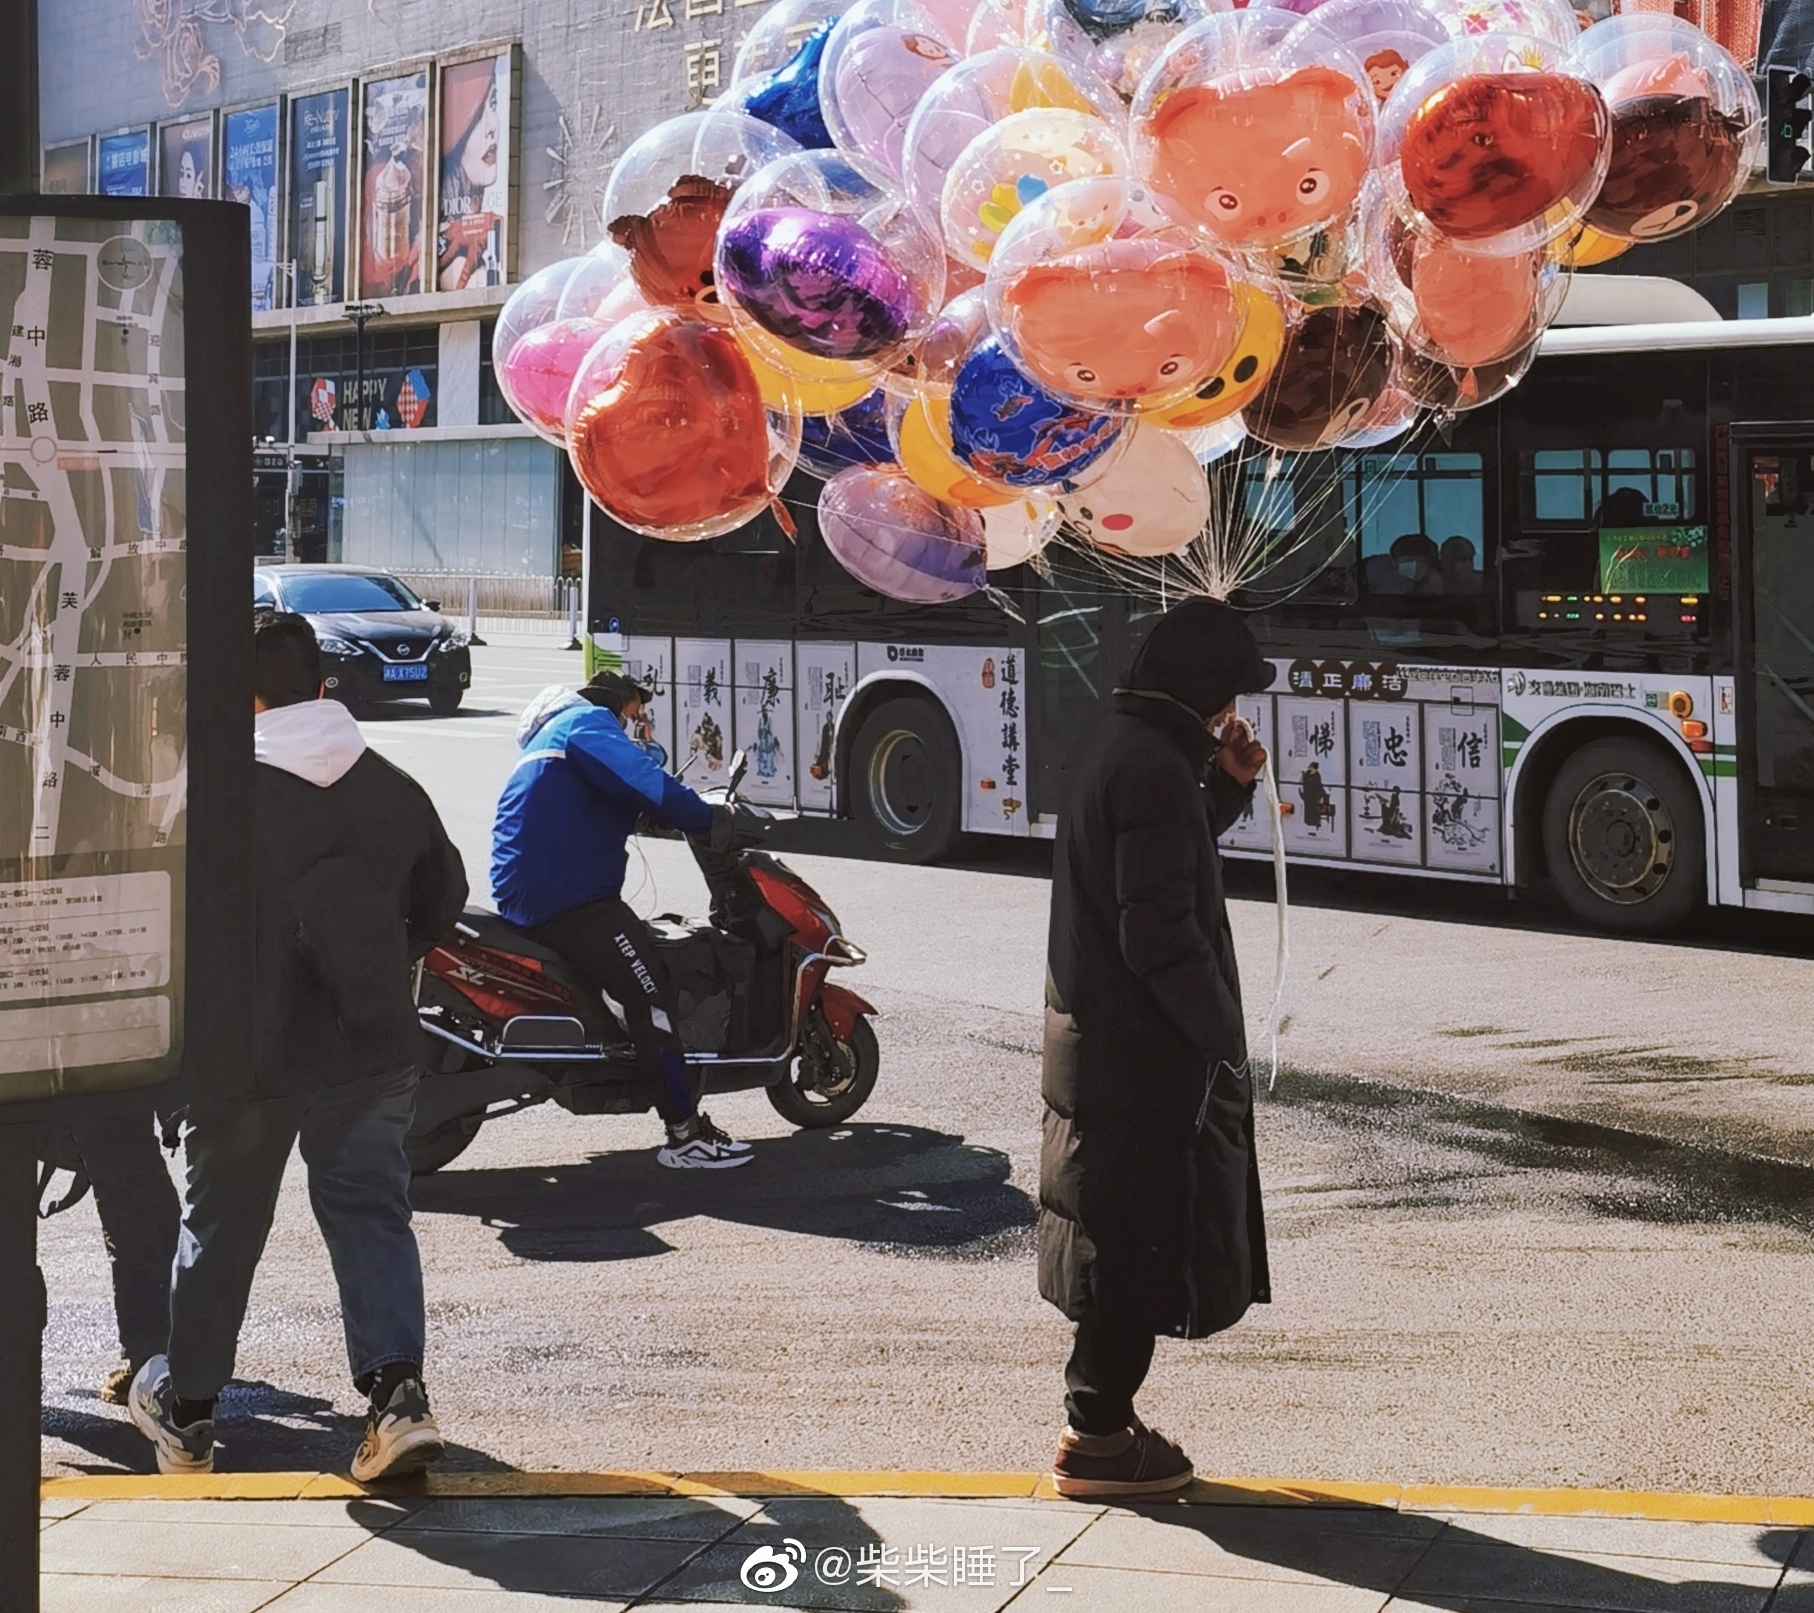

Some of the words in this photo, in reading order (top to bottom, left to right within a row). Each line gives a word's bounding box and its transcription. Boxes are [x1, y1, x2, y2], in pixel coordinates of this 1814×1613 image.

[343, 377, 388, 404] HAPPY
[1383, 726, 1408, 767] 忠
[1457, 732, 1483, 769] 信
[613, 932, 637, 959] XTEP
